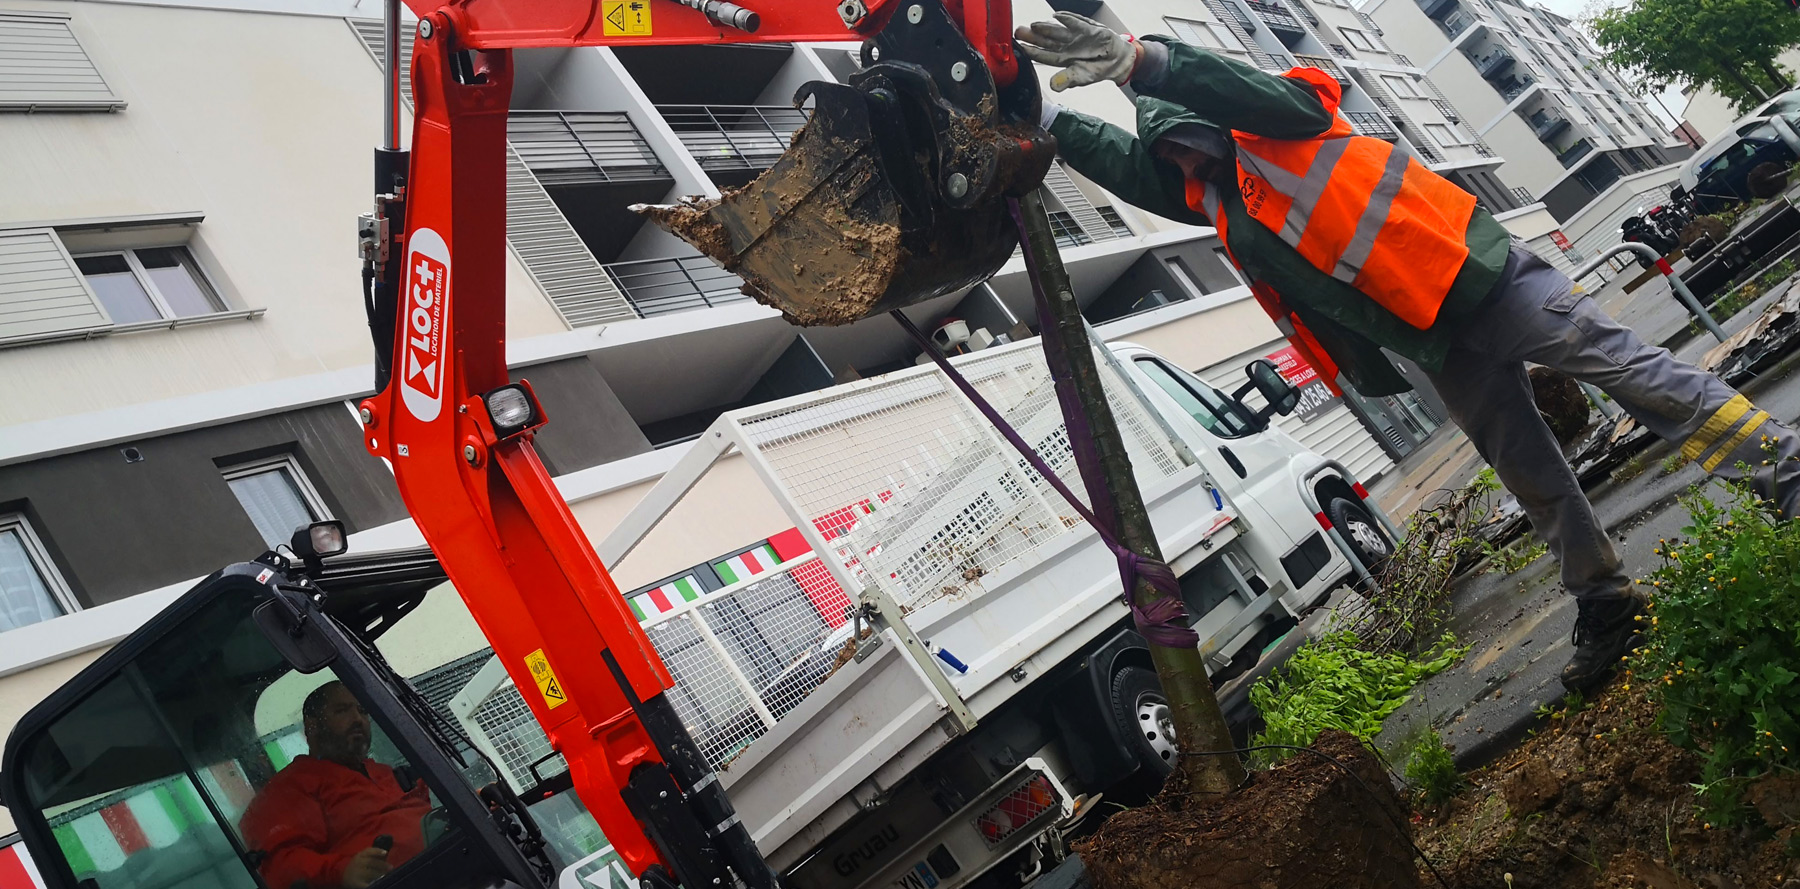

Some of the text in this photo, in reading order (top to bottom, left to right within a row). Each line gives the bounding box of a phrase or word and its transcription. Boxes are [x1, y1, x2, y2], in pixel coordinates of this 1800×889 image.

[431, 268, 443, 357] LOCATION DE MATERIEL
[1305, 387, 1322, 407] 25
[1313, 383, 1330, 402] 46
[833, 823, 899, 877] Gruau
